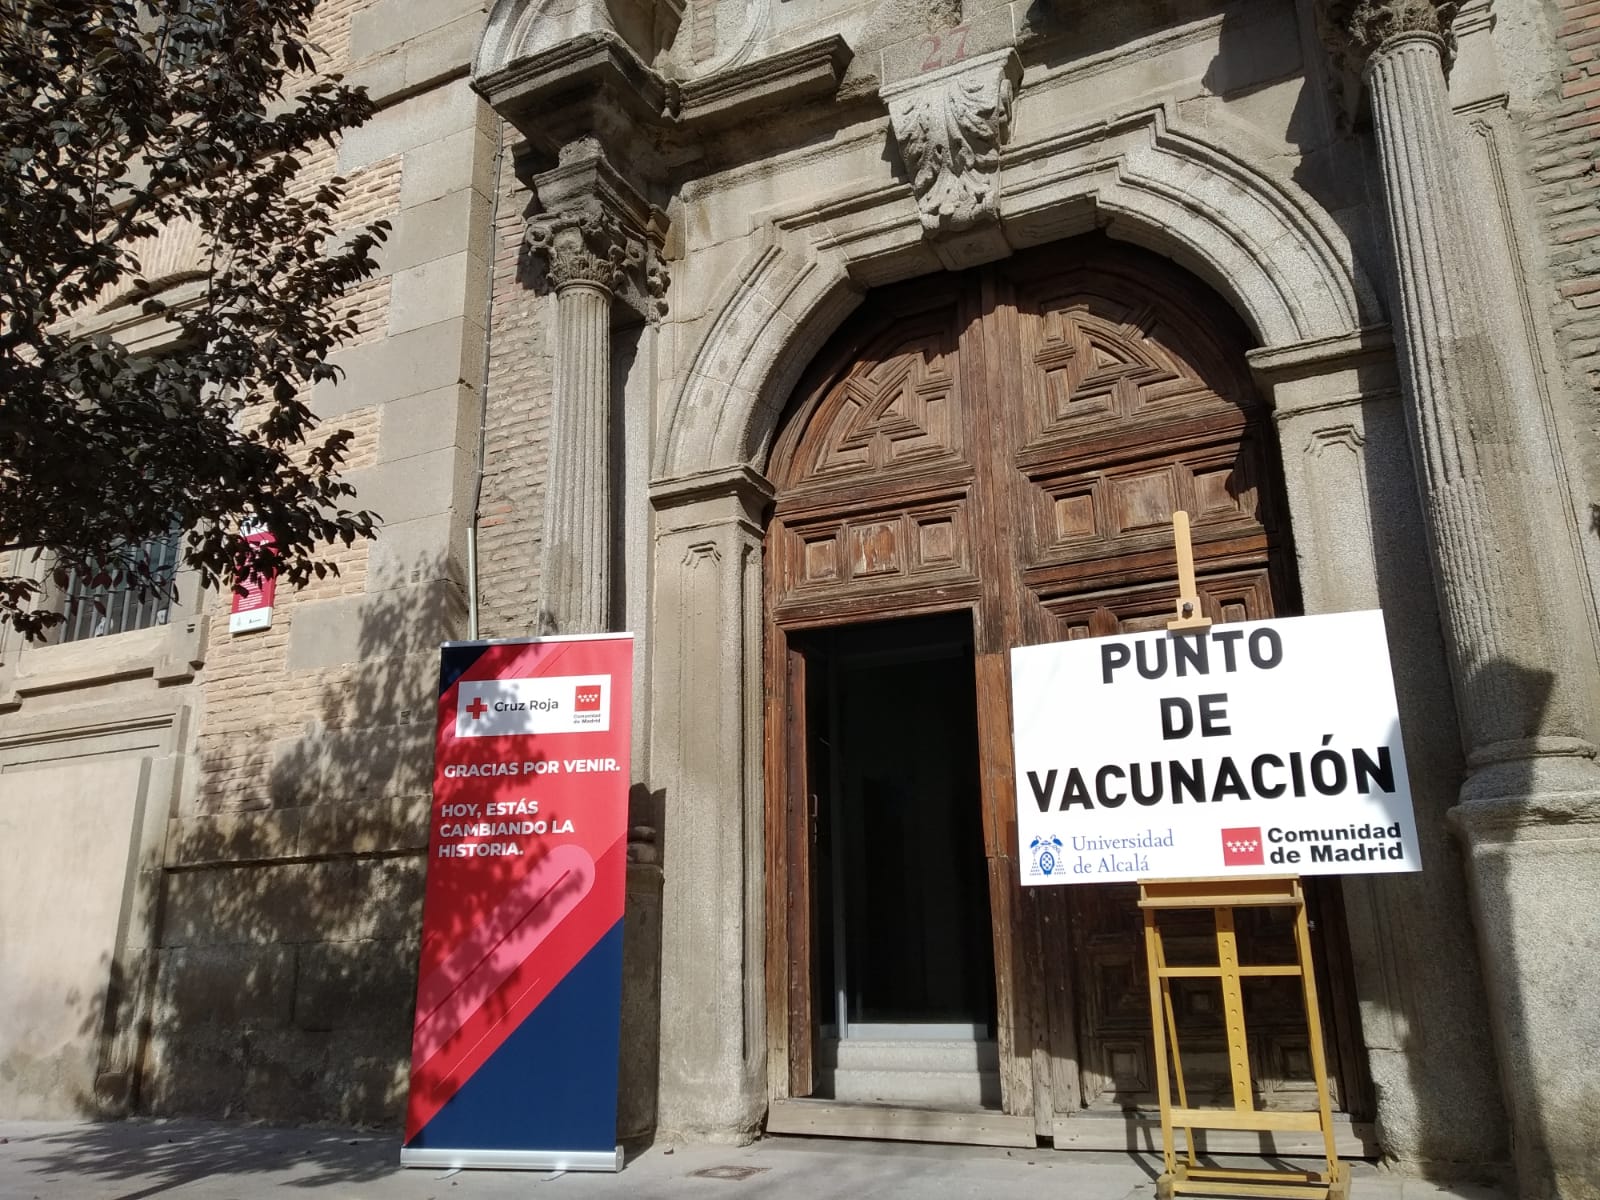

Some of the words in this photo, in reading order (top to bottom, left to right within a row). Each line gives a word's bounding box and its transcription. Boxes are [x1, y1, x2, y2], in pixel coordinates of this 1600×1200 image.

[919, 24, 972, 71] 27
[1100, 627, 1283, 684] PUNTO
[494, 701, 525, 712] Cruz
[530, 698, 559, 712] Roja
[1159, 692, 1232, 740] DE
[444, 762, 519, 778] GRACIAS
[523, 760, 559, 775] POR
[564, 758, 620, 773] VENIR.
[1026, 734, 1396, 812] VACUNACIÓN
[441, 803, 482, 818] HOY,
[486, 798, 538, 816] ESTÁS
[439, 820, 547, 837] CAMBIANDO
[552, 819, 574, 834] LA
[1267, 822, 1402, 843] Comunidad
[438, 842, 524, 858] HISTORIA.
[1072, 828, 1174, 851] Universidad
[1073, 855, 1092, 874] de
[1097, 853, 1150, 873] Alcalá
[1270, 846, 1301, 864] de
[1310, 842, 1404, 863] Madrid
